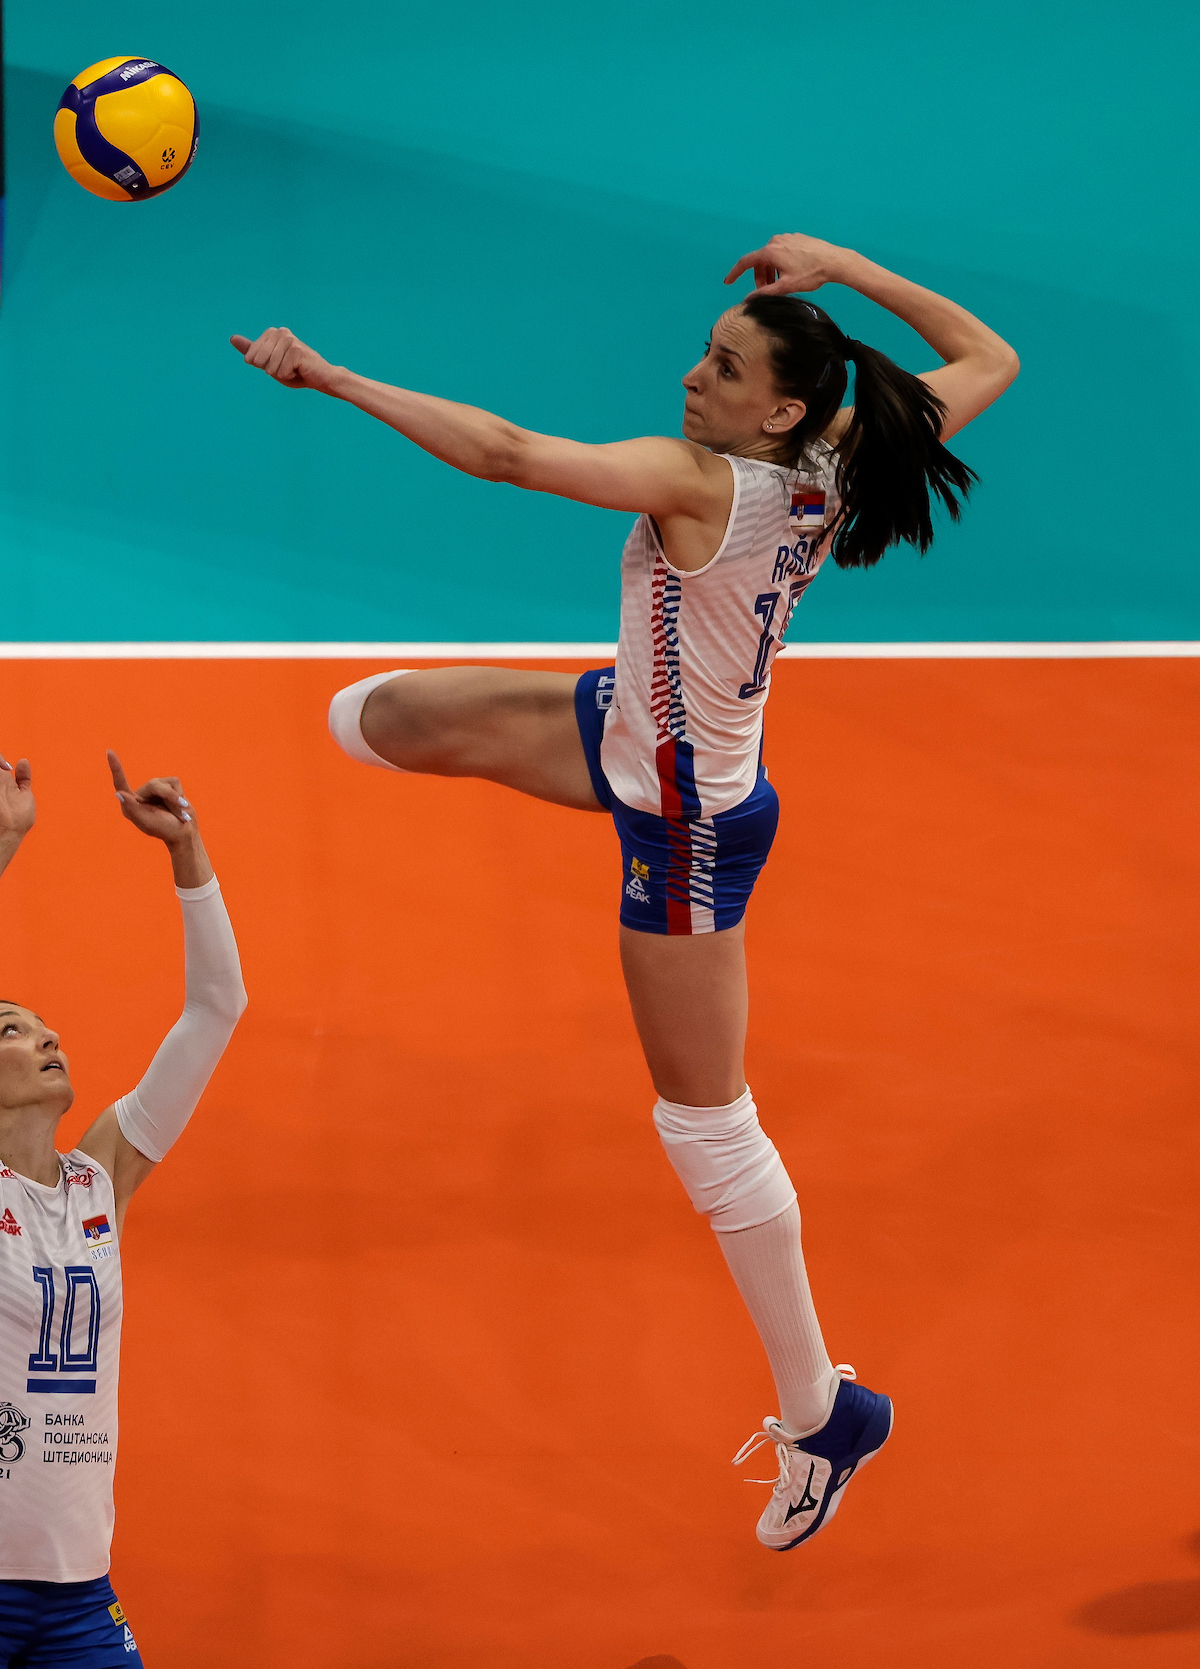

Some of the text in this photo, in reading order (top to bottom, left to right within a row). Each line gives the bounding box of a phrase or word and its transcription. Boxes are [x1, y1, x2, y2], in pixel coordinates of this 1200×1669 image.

[626, 884, 651, 904] PEAK
[28, 1266, 101, 1372] 10
[45, 1413, 85, 1426] БАНКА
[44, 1432, 109, 1444] ПОШТАНСКА
[43, 1451, 113, 1465] ШТЕДИОНИЦА
